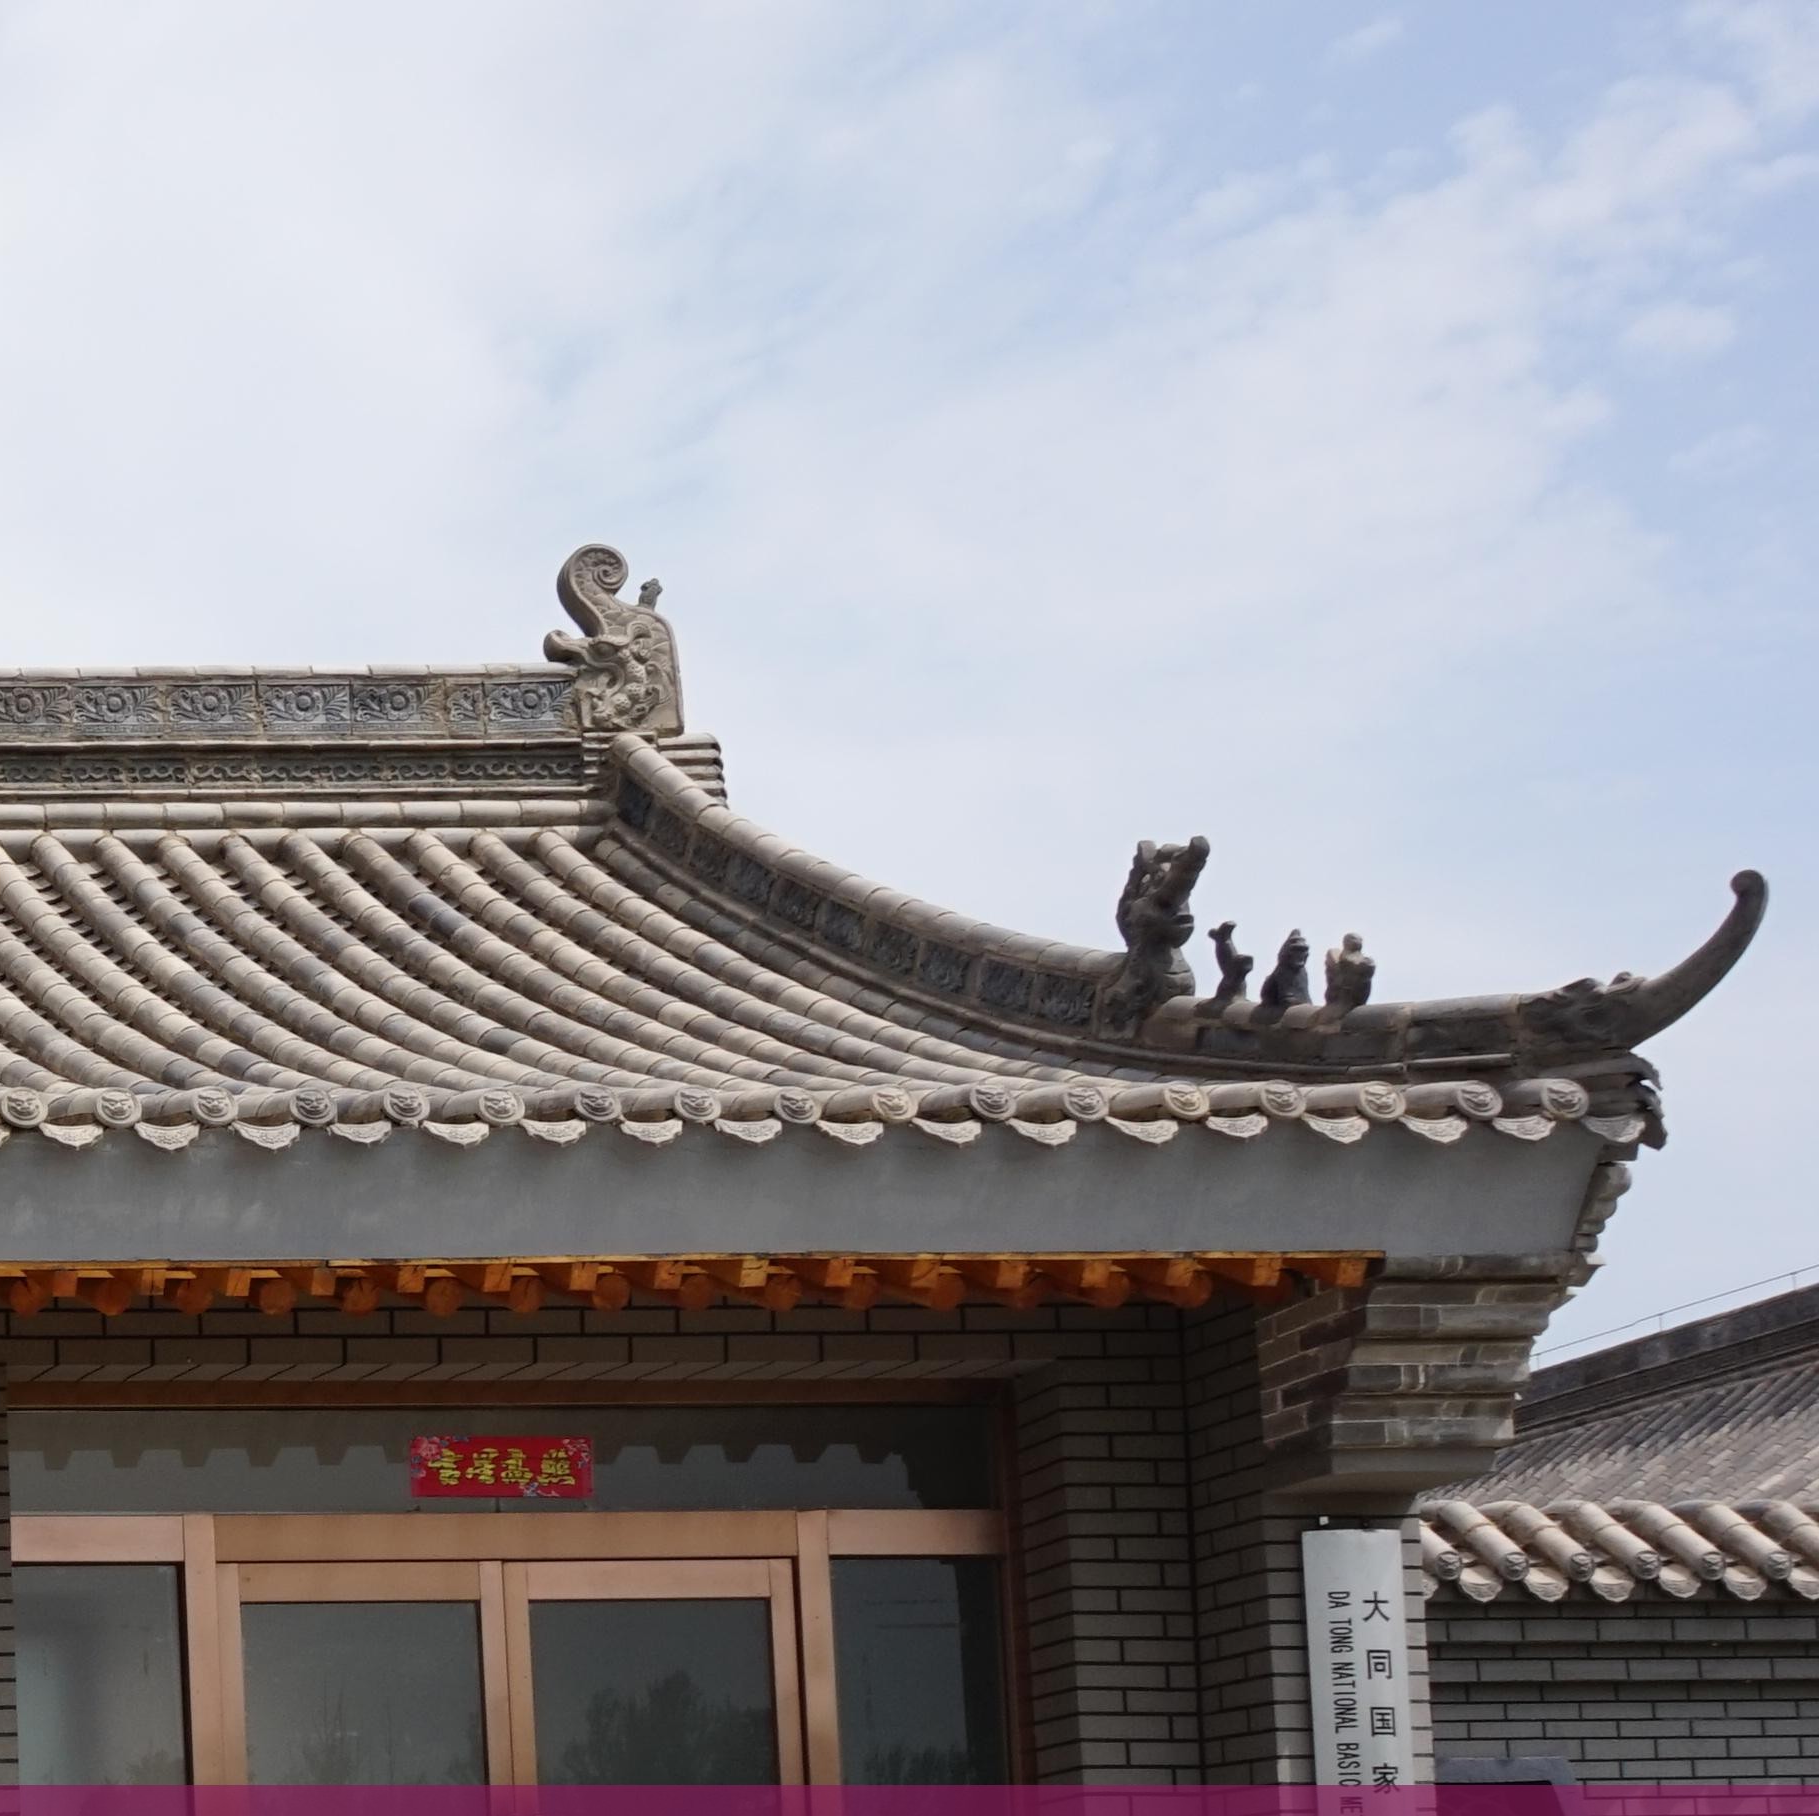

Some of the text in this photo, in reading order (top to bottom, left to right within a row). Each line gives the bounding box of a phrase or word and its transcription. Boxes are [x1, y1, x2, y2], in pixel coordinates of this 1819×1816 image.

[1327, 1590, 1351, 1609] DA
[1328, 1620, 1354, 1653] TONG
[1331, 1662, 1358, 1733] NATIONAL
[1336, 1742, 1362, 1787] BASIC
